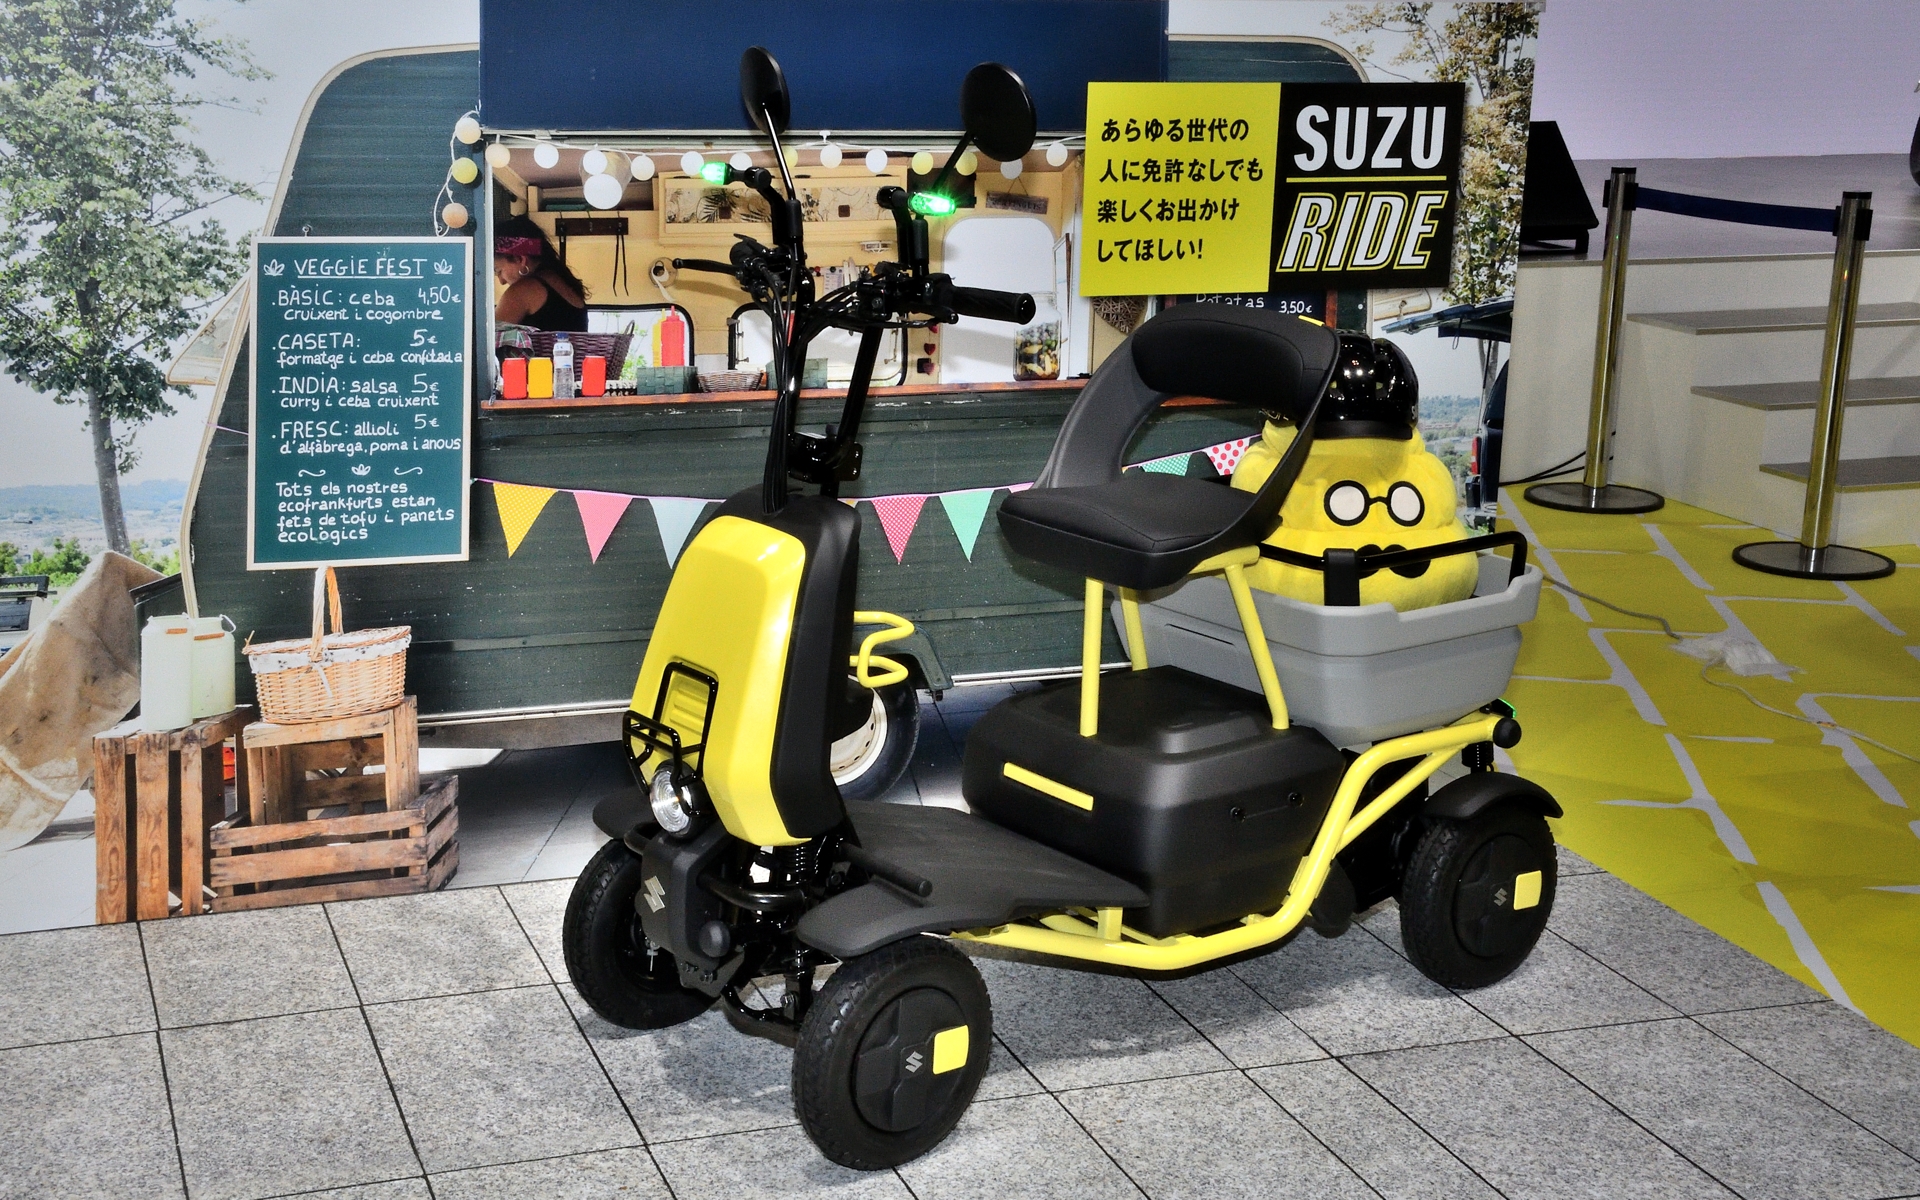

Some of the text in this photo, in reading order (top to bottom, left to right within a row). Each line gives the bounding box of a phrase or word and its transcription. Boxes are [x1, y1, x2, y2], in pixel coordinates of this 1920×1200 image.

[1101, 118, 1249, 143] あらゆる世代の
[1293, 104, 1447, 172] SUZU
[1099, 158, 1264, 183] 人に免許なしでも
[1097, 198, 1240, 223] 楽しくお出かけ
[1275, 189, 1449, 273] RIDE
[376, 257, 428, 276] FEST
[349, 290, 395, 306] ceba
[284, 307, 443, 324] cruixent i cogombre
[409, 329, 438, 347] 5€
[277, 348, 463, 369] formatge i ceba confitada
[350, 378, 398, 393] salsa
[411, 373, 439, 393] 5€
[280, 392, 439, 411] curry i ceba cruixent
[354, 421, 400, 436] allioli
[414, 413, 440, 429] 5€
[421, 437, 461, 450] anous
[276, 482, 408, 497] Tots els nostres
[278, 495, 436, 514] ecofrankfurts estan
[277, 509, 455, 532] fets de tofu i panets
